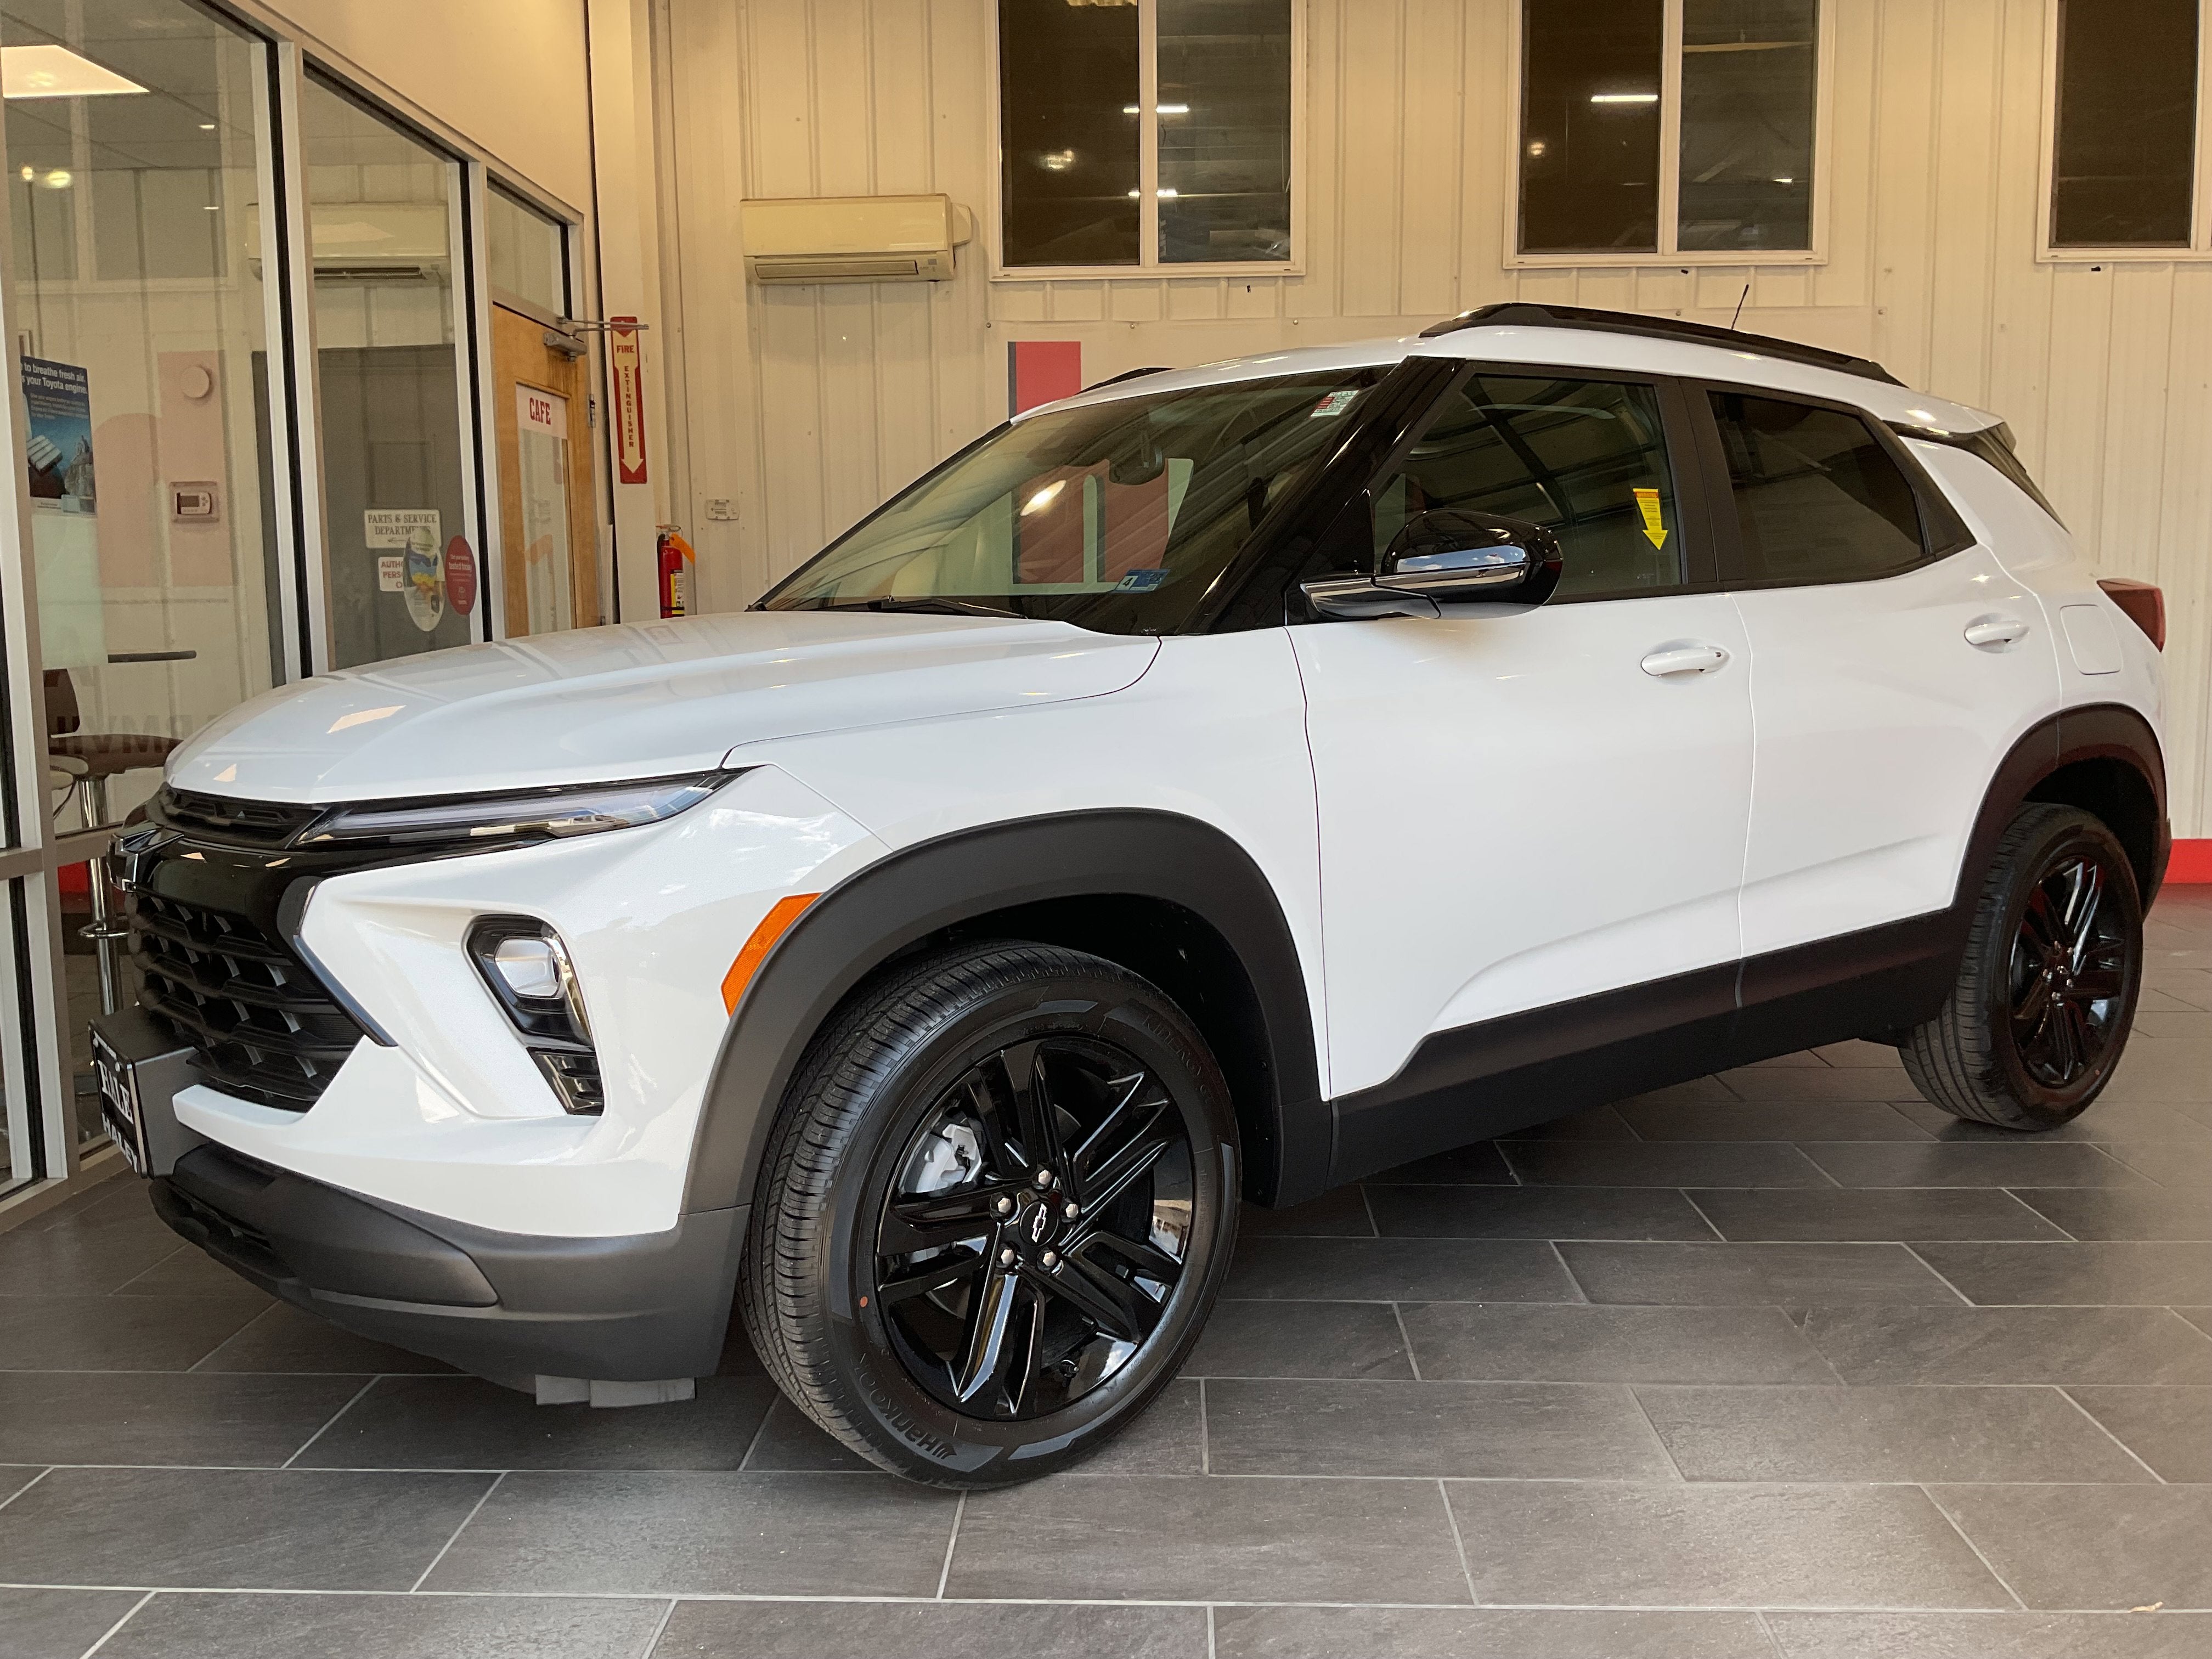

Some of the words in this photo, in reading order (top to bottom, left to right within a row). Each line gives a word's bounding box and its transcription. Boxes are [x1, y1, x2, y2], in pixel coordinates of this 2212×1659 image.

[617, 345, 634, 354] FIRE
[24, 363, 31, 373] to
[33, 363, 58, 377] breathe
[59, 369, 75, 381] fresh
[26, 375, 42, 386] your
[42, 377, 64, 390] Toyota
[529, 397, 551, 425] CAFE
[623, 365, 634, 448] EXTINGUISHER
[368, 514, 393, 523] PARTS
[395, 515, 402, 523] &
[403, 514, 437, 523] SERVICE
[1122, 577, 1134, 587] 4
[101, 1111, 138, 1173] HALEY
